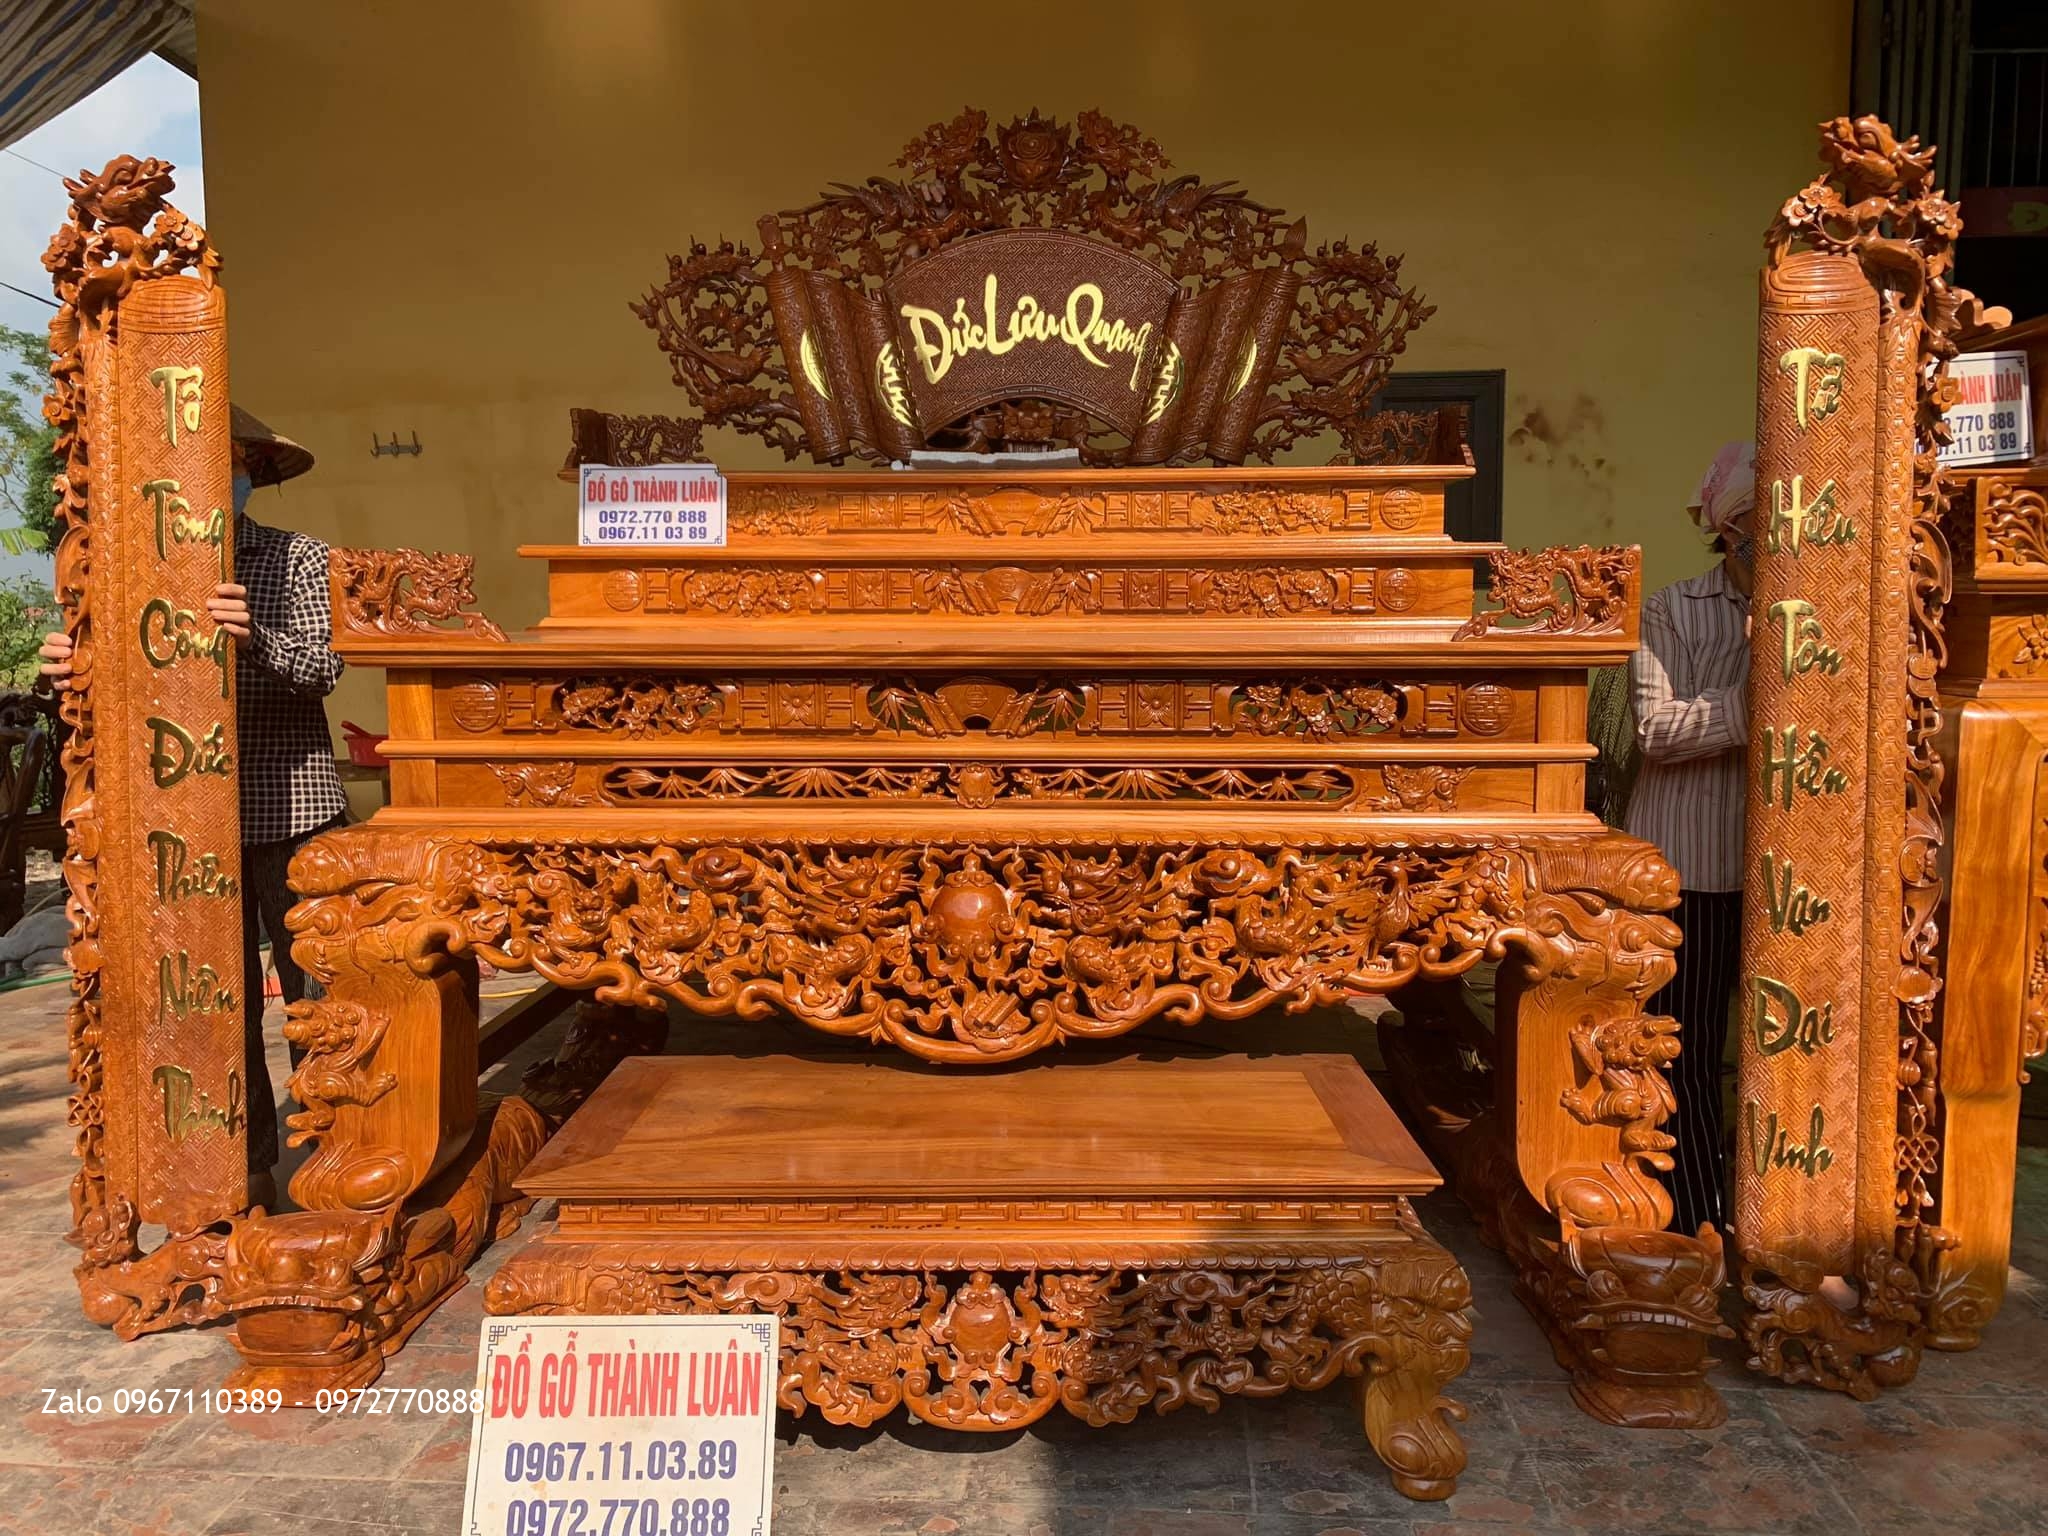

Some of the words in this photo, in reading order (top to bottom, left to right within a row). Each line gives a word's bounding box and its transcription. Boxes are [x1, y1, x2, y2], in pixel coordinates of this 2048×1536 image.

[900, 298, 987, 385] Đức
[1978, 434, 1995, 452] 03
[2000, 432, 2016, 449] 89
[1988, 411, 2015, 430] 888
[588, 472, 606, 502] ĐỒ
[633, 476, 677, 502] THÀNH
[682, 476, 718, 502] LUÂN
[598, 510, 672, 524] 0972.770
[677, 510, 707, 524] 888
[142, 479, 227, 583] Tông
[598, 526, 657, 540] 0967.11
[664, 526, 683, 540] 03
[688, 526, 707, 540] 89
[139, 597, 230, 699] Công
[1768, 599, 1843, 685] Tôn
[145, 716, 233, 789] Đức
[147, 830, 239, 905] Thiên
[159, 949, 238, 1027] Niên
[1745, 1098, 1834, 1178] Vinh
[491, 1333, 532, 1419] ĐỒ
[539, 1331, 579, 1418] GỖ
[587, 1339, 680, 1417] THÀNH
[687, 1339, 762, 1416] LUÂN
[504, 1440, 737, 1482] 0967.11.03.89
[506, 1498, 730, 1536] 0972.770.888
